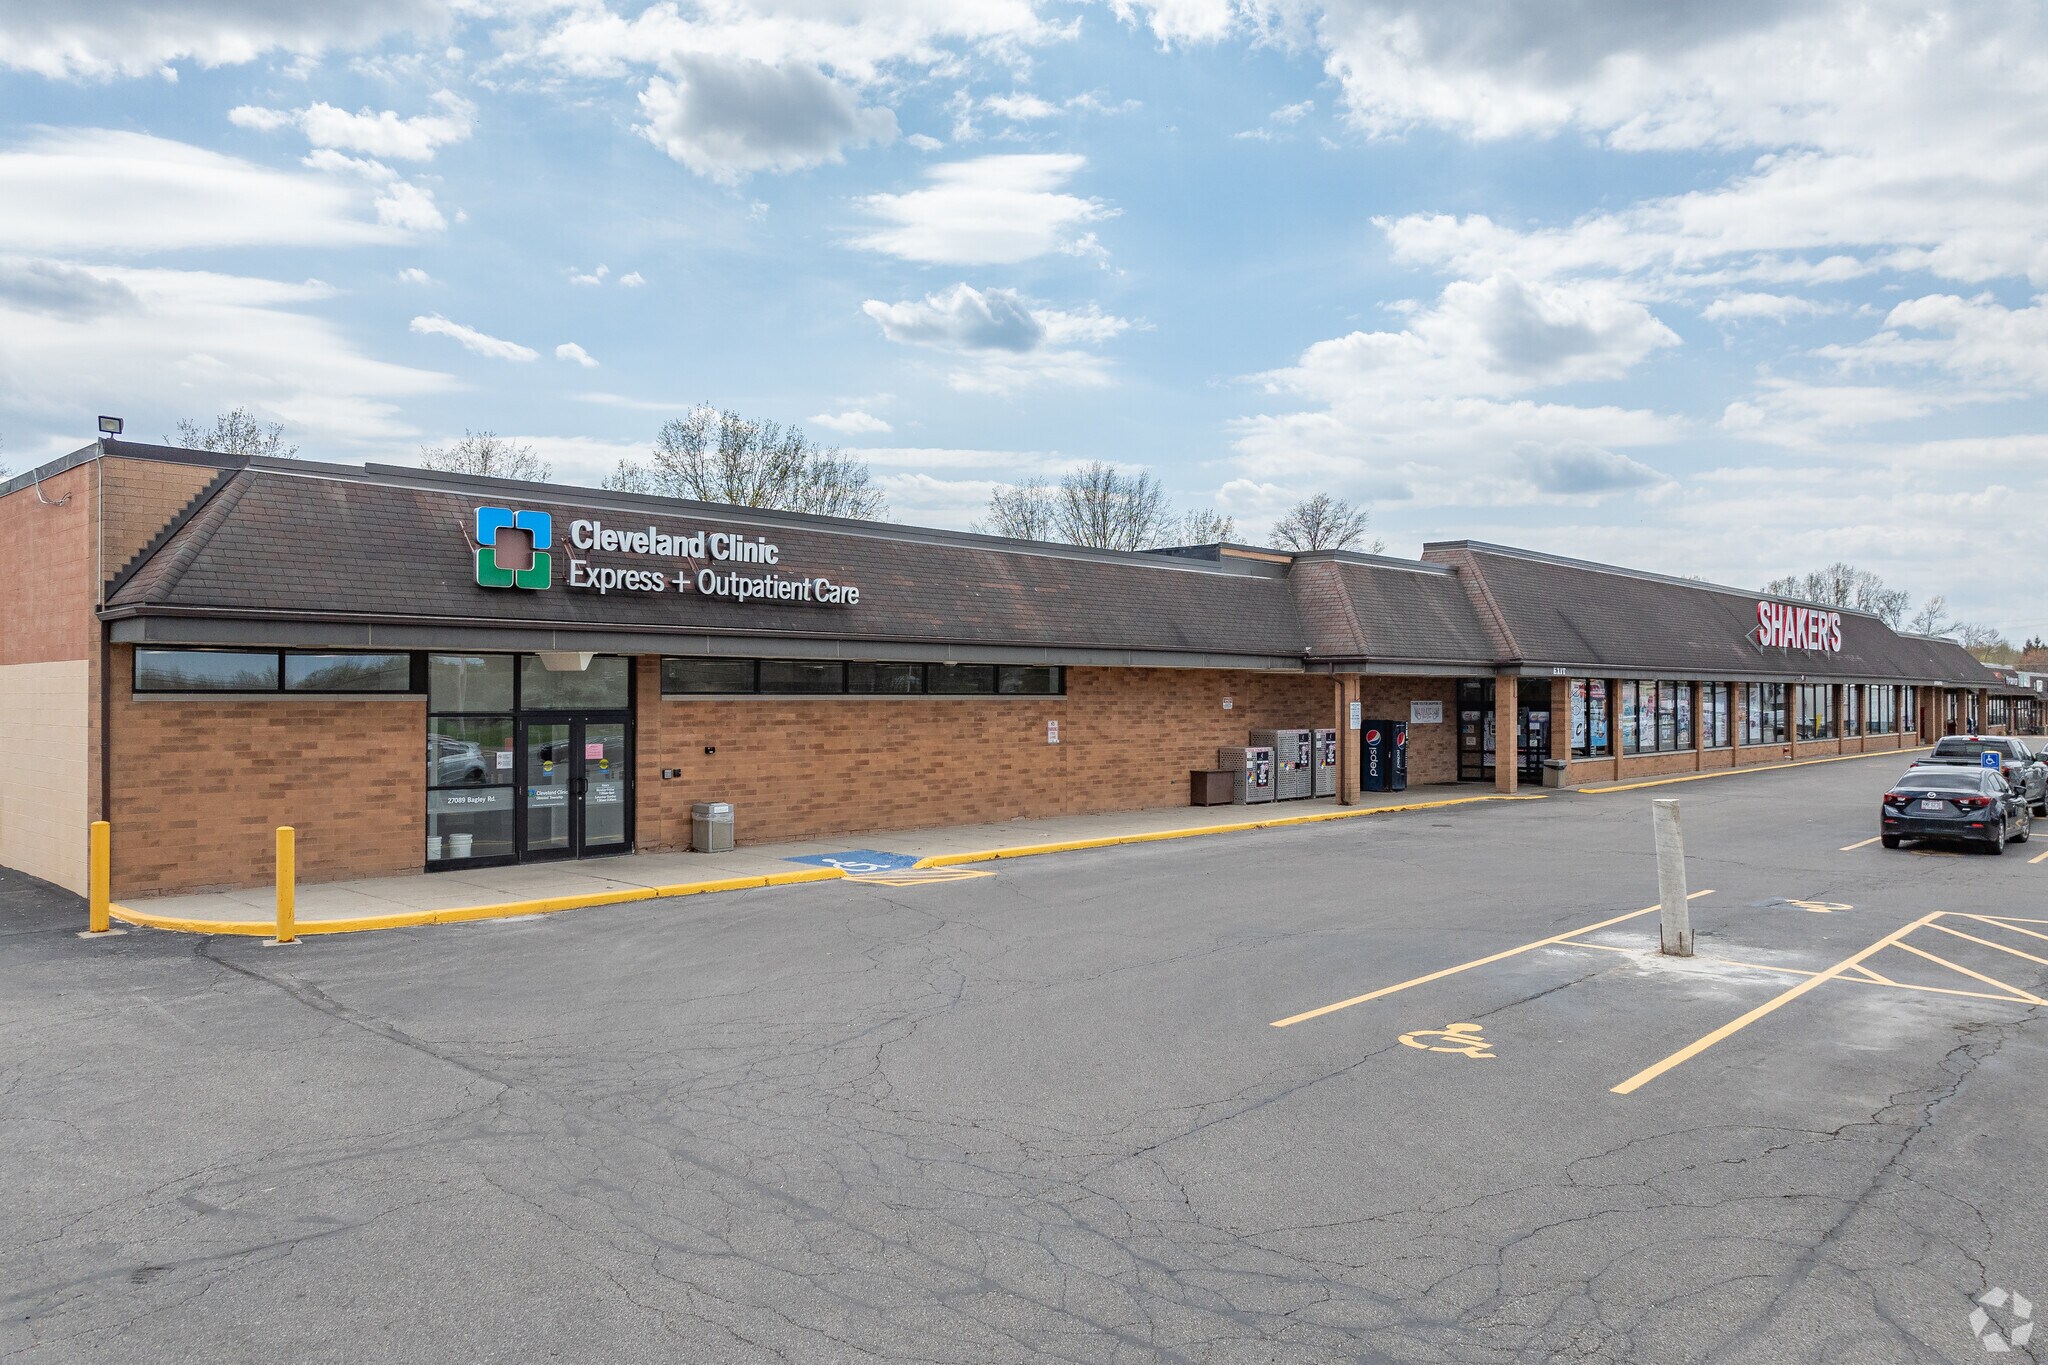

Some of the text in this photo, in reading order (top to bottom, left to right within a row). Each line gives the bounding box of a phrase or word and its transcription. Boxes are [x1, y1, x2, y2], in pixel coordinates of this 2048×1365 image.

[568, 519, 779, 565] Cleveland Clinic
[569, 559, 860, 605] Express + Outpatient Care
[1757, 601, 1842, 653] SHAKER'S
[1368, 747, 1379, 777] pepsi
[447, 796, 466, 804] 27089
[467, 796, 487, 804] Bagley
